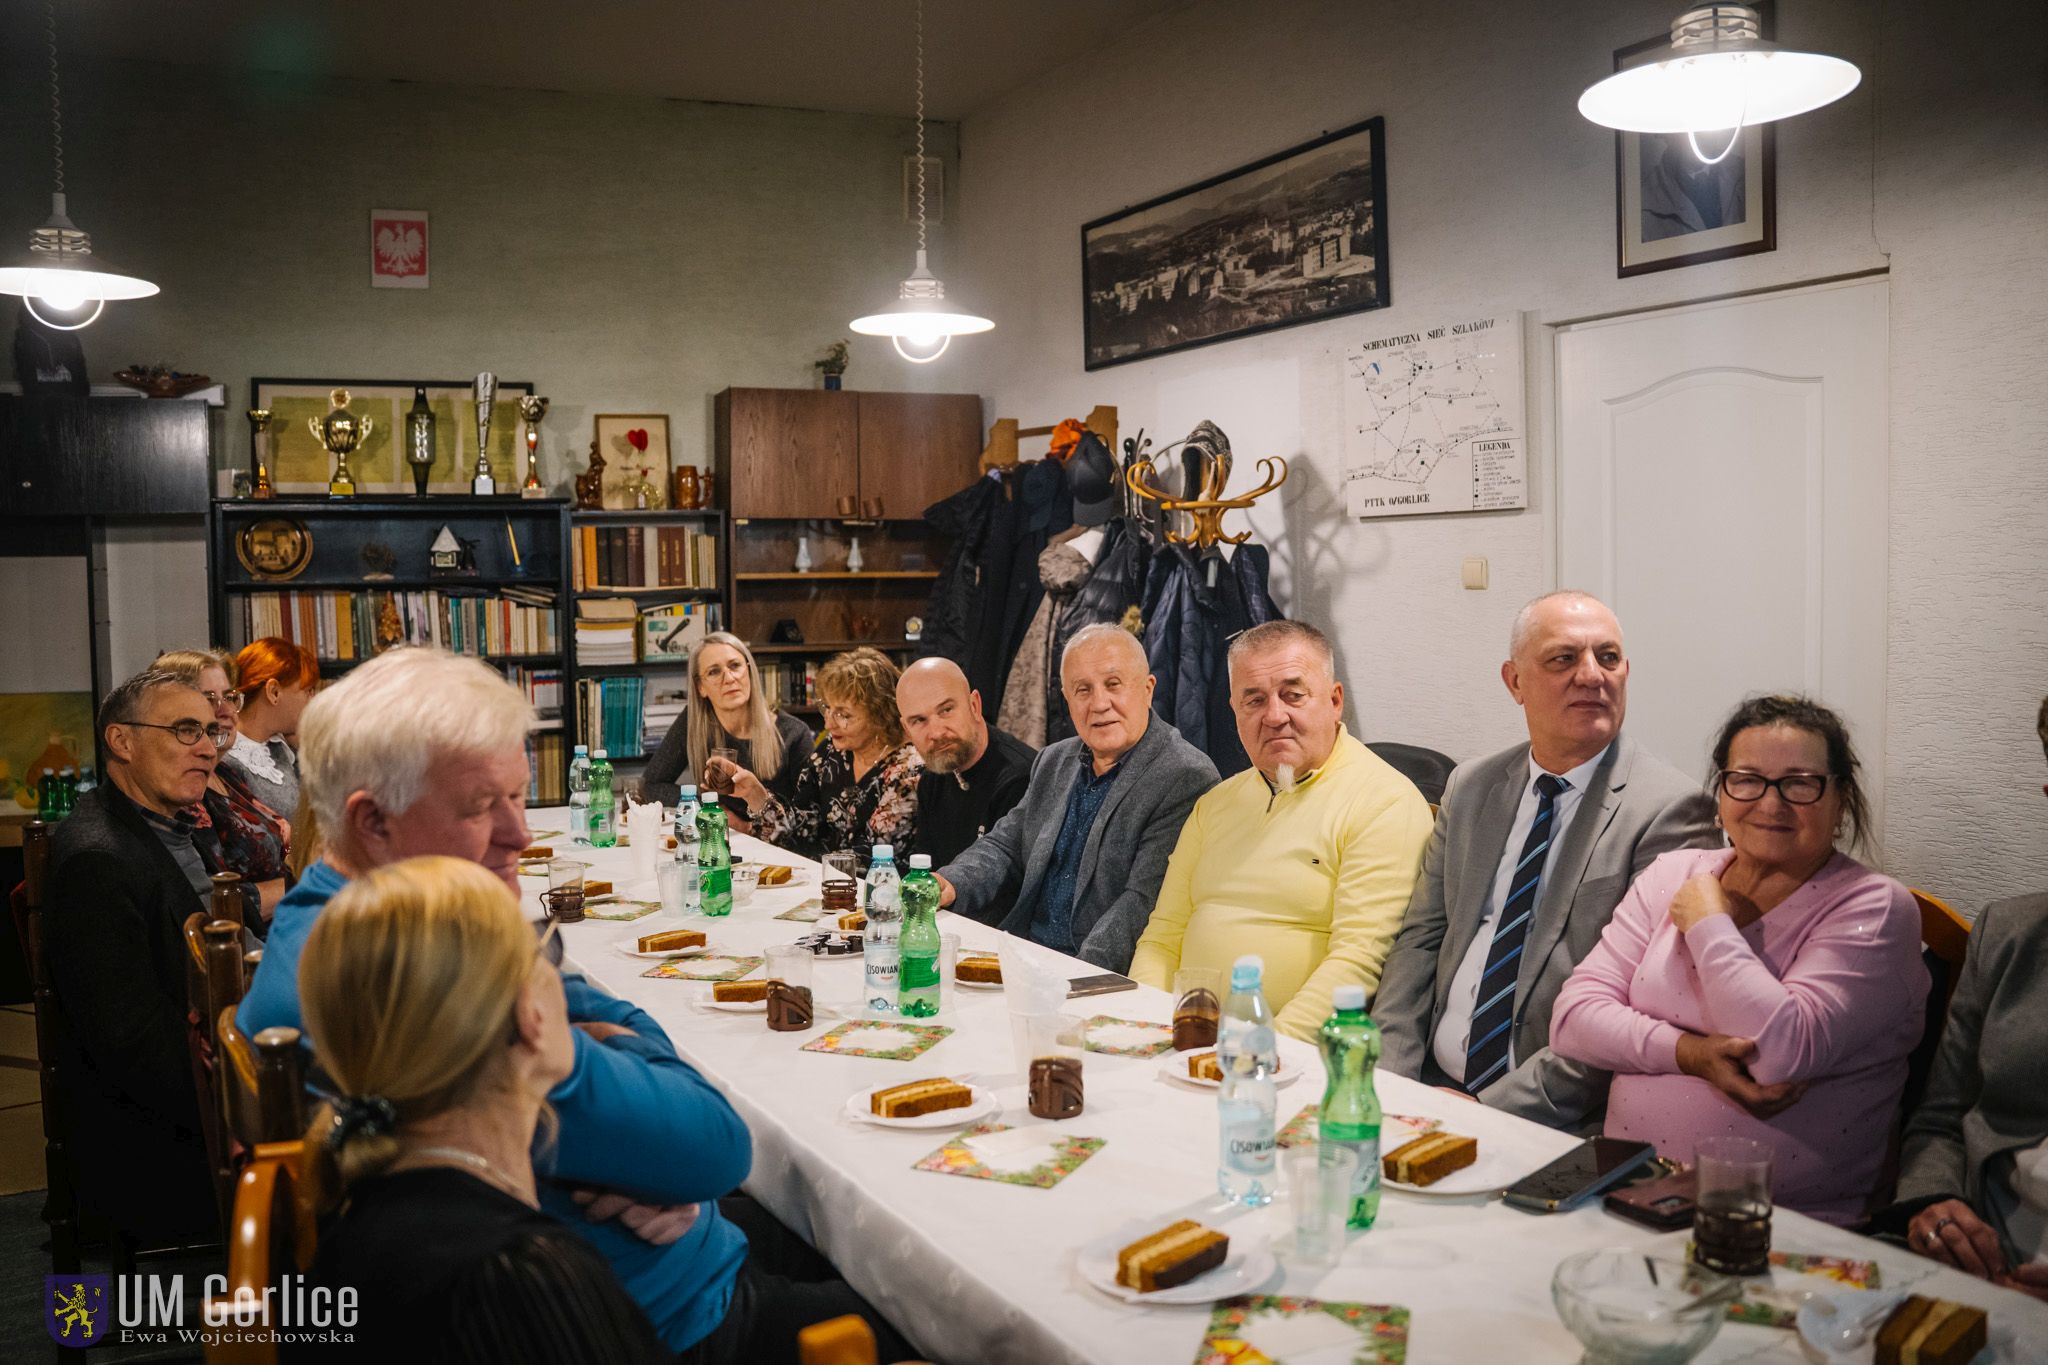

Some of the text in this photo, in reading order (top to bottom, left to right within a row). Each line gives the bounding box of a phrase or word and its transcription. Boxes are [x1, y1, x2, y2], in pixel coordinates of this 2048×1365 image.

[1363, 332, 1421, 352] SCHEMATYCZNA
[1452, 318, 1495, 335] SZLAKÓW
[1479, 441, 1511, 452] LEGENDA
[1364, 497, 1385, 508] PTTK
